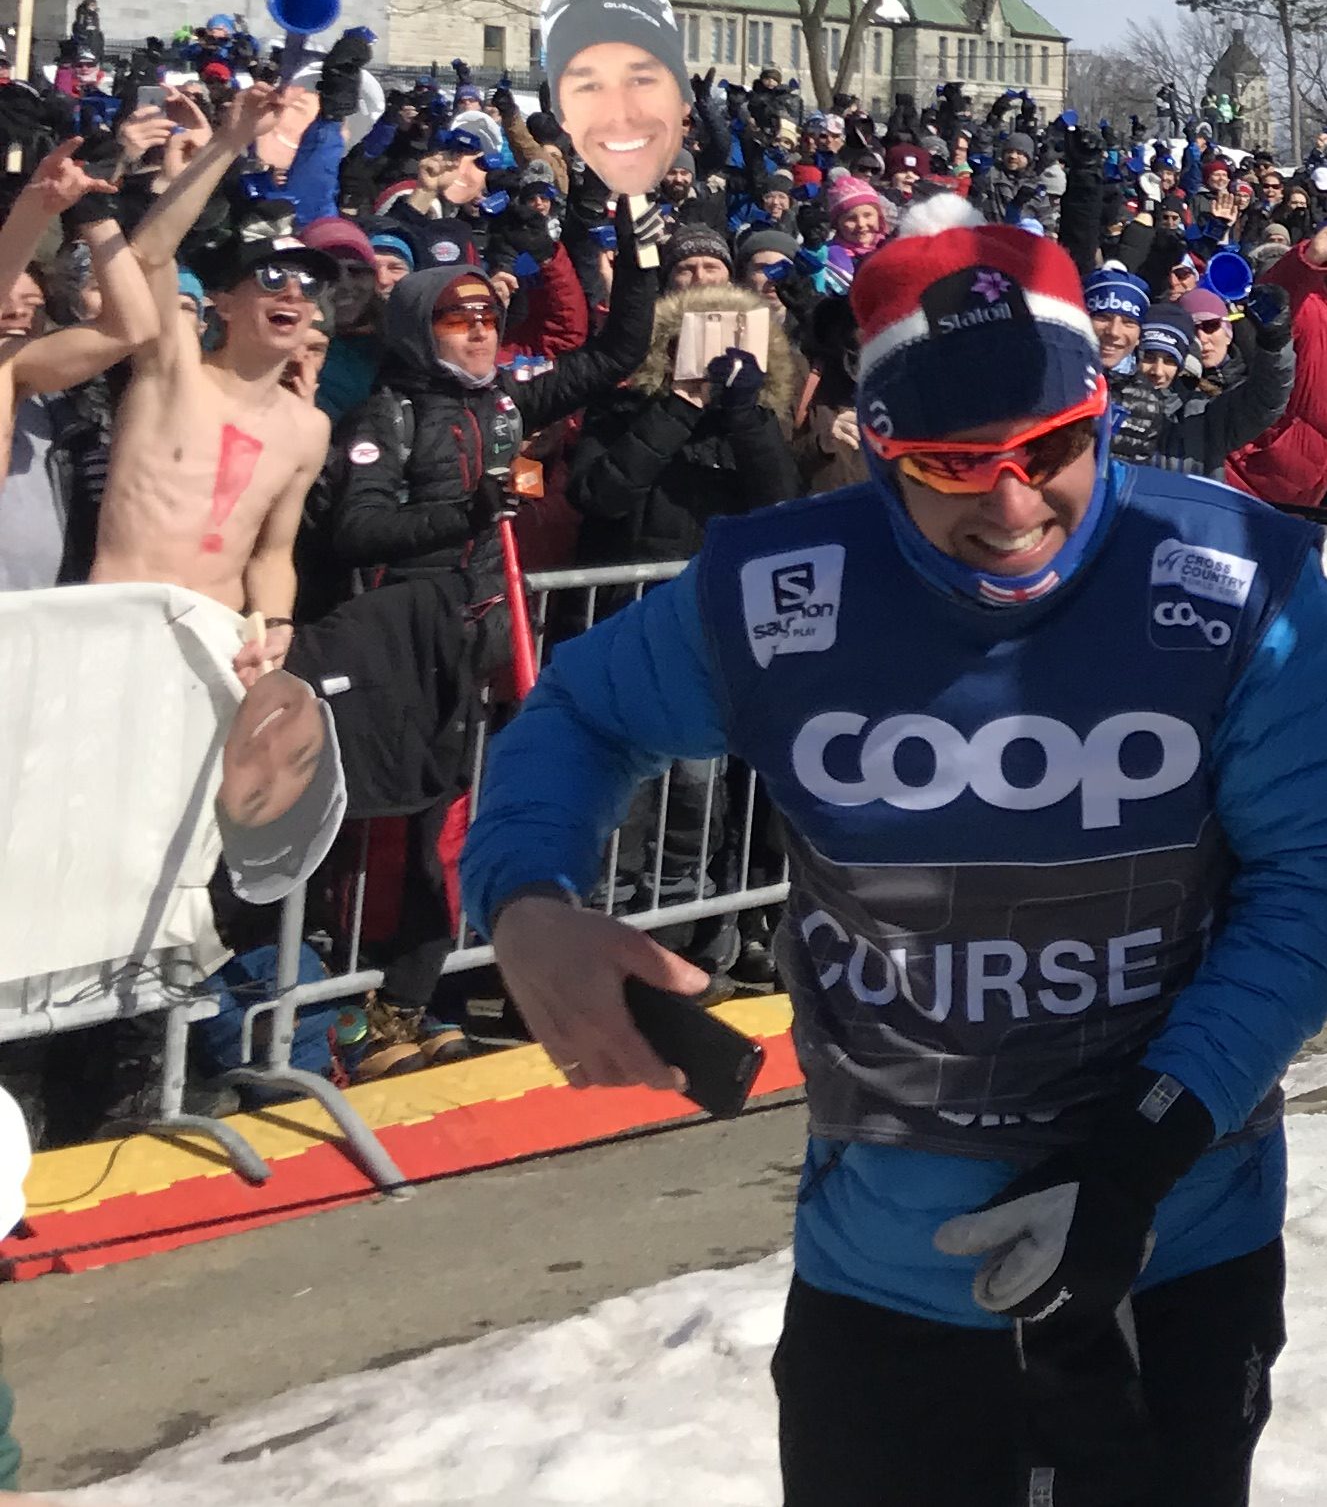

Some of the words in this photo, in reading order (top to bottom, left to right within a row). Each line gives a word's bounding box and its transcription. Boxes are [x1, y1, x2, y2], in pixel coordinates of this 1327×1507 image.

[937, 301, 1013, 334] Statoil
[1182, 564, 1247, 588] COUNTRY
[1185, 554, 1232, 574] CROSS
[793, 711, 1201, 830] coop
[801, 909, 1166, 1024] COURSE
